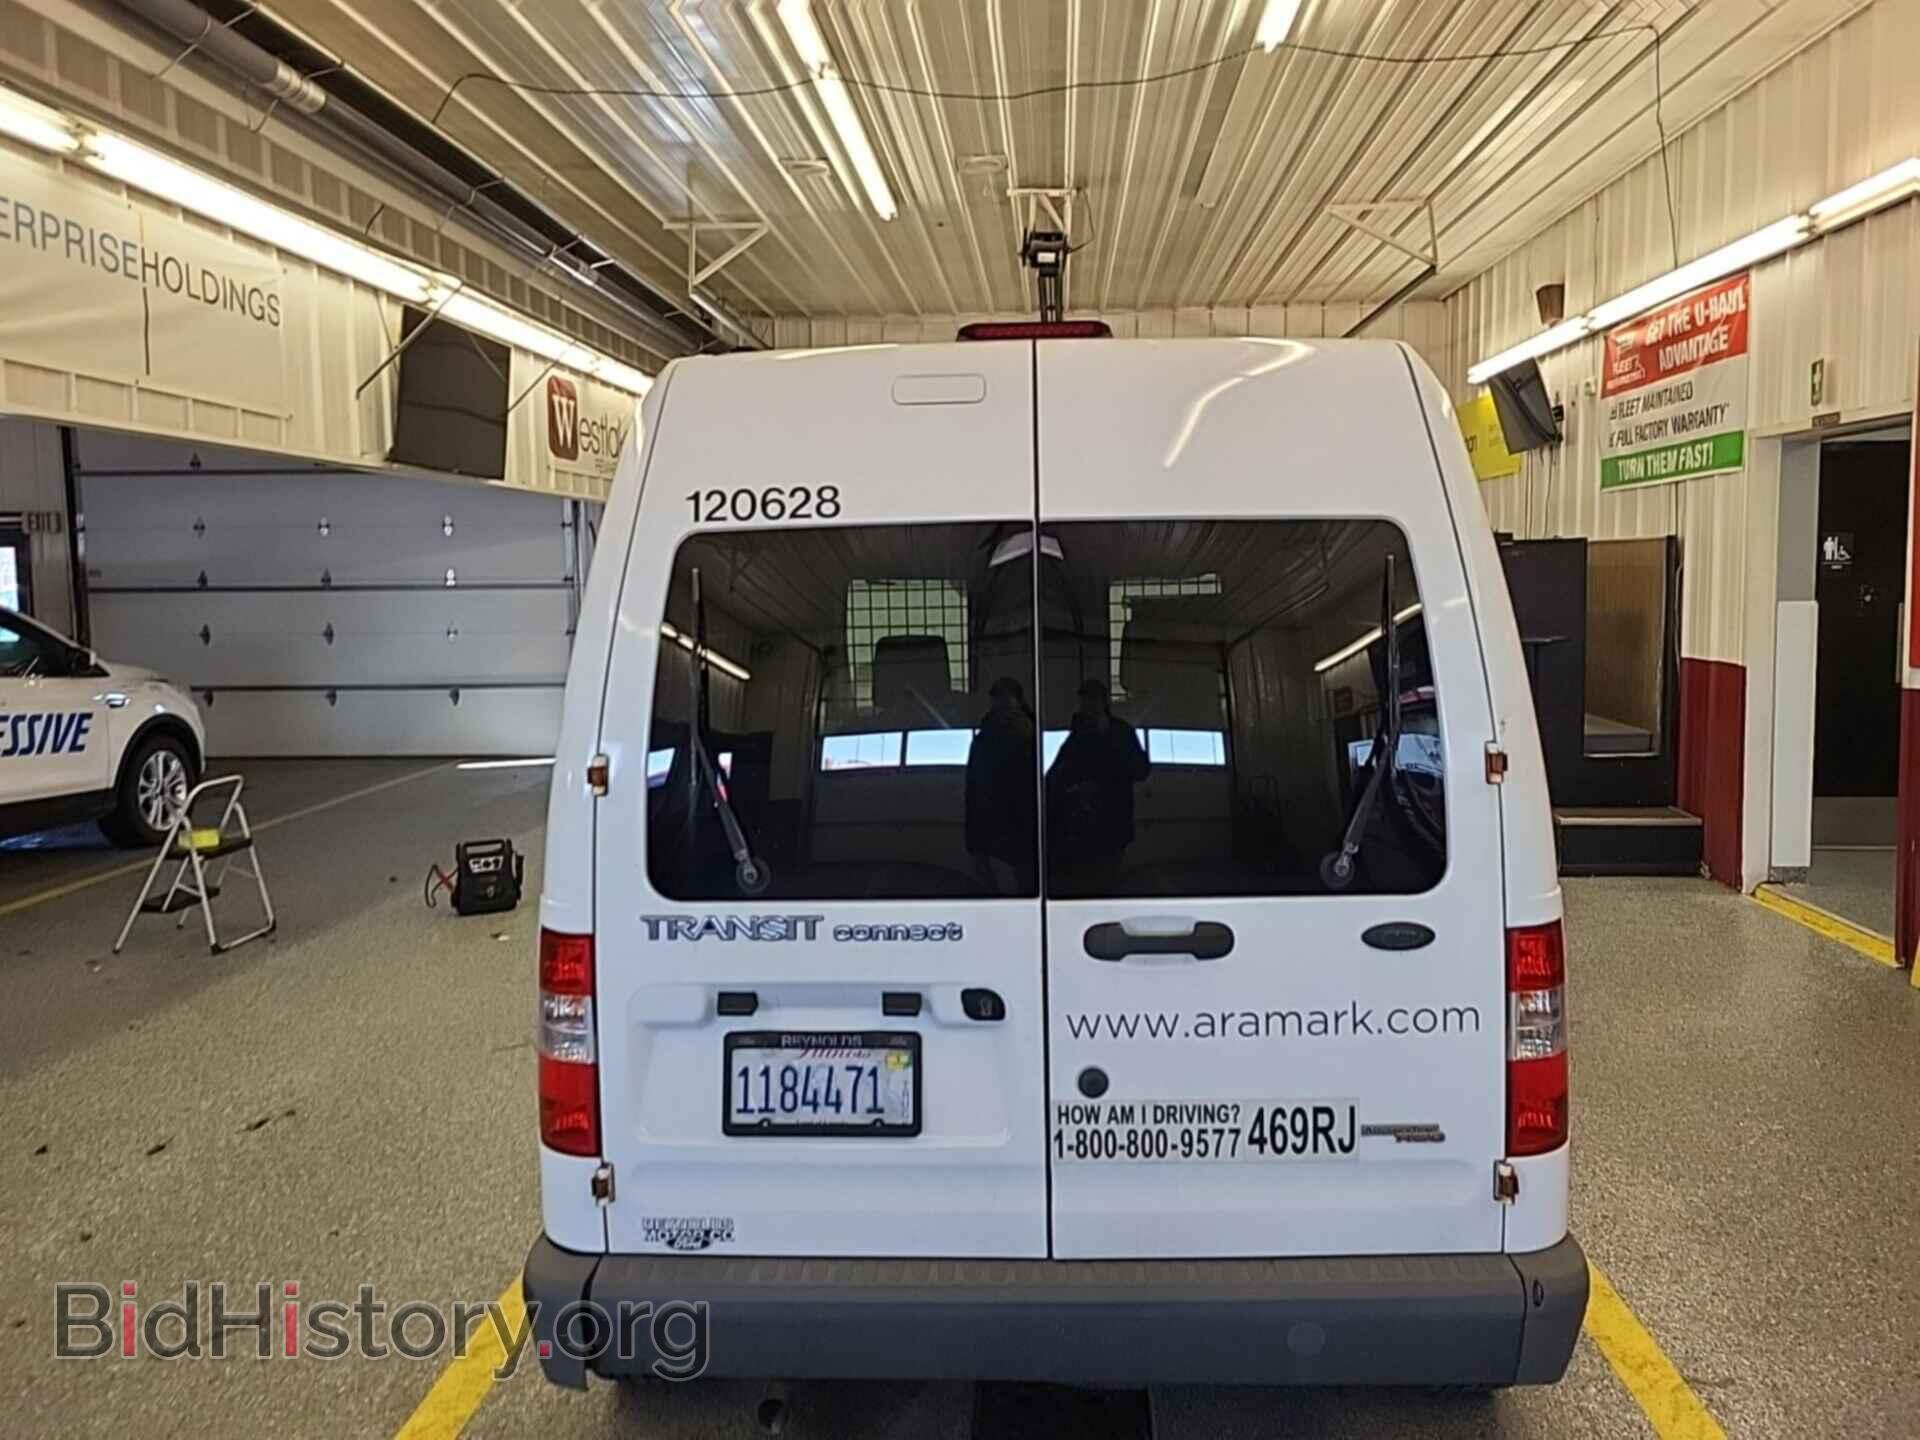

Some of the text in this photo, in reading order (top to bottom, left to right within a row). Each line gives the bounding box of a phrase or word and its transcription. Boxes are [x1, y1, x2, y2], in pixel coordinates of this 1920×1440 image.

[1658, 324, 1729, 371] ADVANTAGE
[1646, 449, 1678, 477] THEM
[1678, 441, 1714, 471] FAST!
[686, 485, 841, 523] 120628
[640, 915, 963, 942] TRANSIT connect
[1065, 1001, 1480, 1040] www.aramark.com
[736, 1064, 885, 1115] 1184471
[1057, 1104, 1240, 1125] HOW AM I DRIVING?
[1248, 1105, 1356, 1155] 469RJ
[1053, 1128, 1241, 1159] 1-800-800-9577
